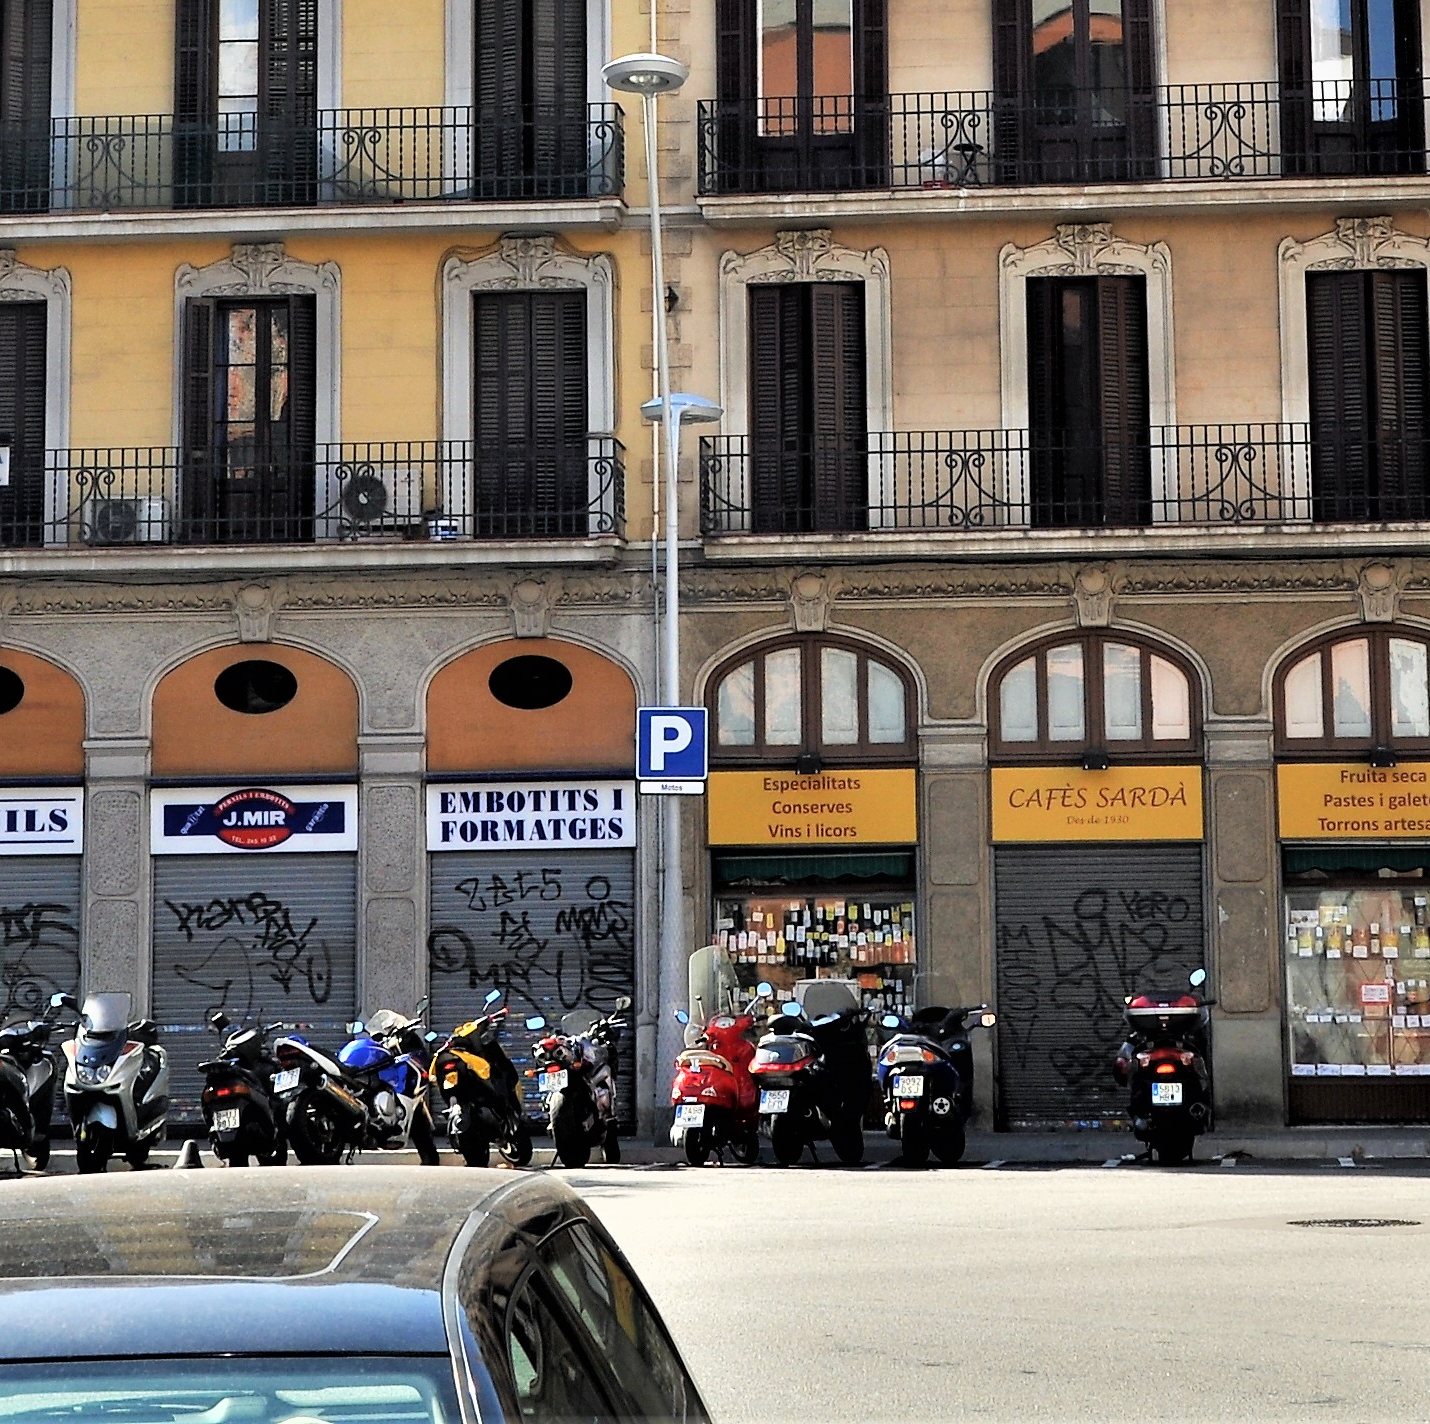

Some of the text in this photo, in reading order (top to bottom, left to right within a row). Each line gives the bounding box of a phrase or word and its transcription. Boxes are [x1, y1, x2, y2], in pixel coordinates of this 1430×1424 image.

[650, 715, 693, 771] P
[1340, 769, 1428, 784] Fruita seca
[762, 776, 861, 794] Especialitats
[439, 788, 624, 815] EMBOTITS I
[1008, 781, 1188, 811] CAFÈS SARDÀ
[1323, 793, 1375, 808] Pastes
[1379, 792, 1384, 807] i
[771, 800, 853, 815] Conserves
[222, 810, 286, 827] J.MIR
[1087, 815, 1101, 825] de
[1317, 816, 1380, 832] Torrons
[440, 817, 624, 843] FORMATGES
[767, 823, 858, 839] Vins i licors
